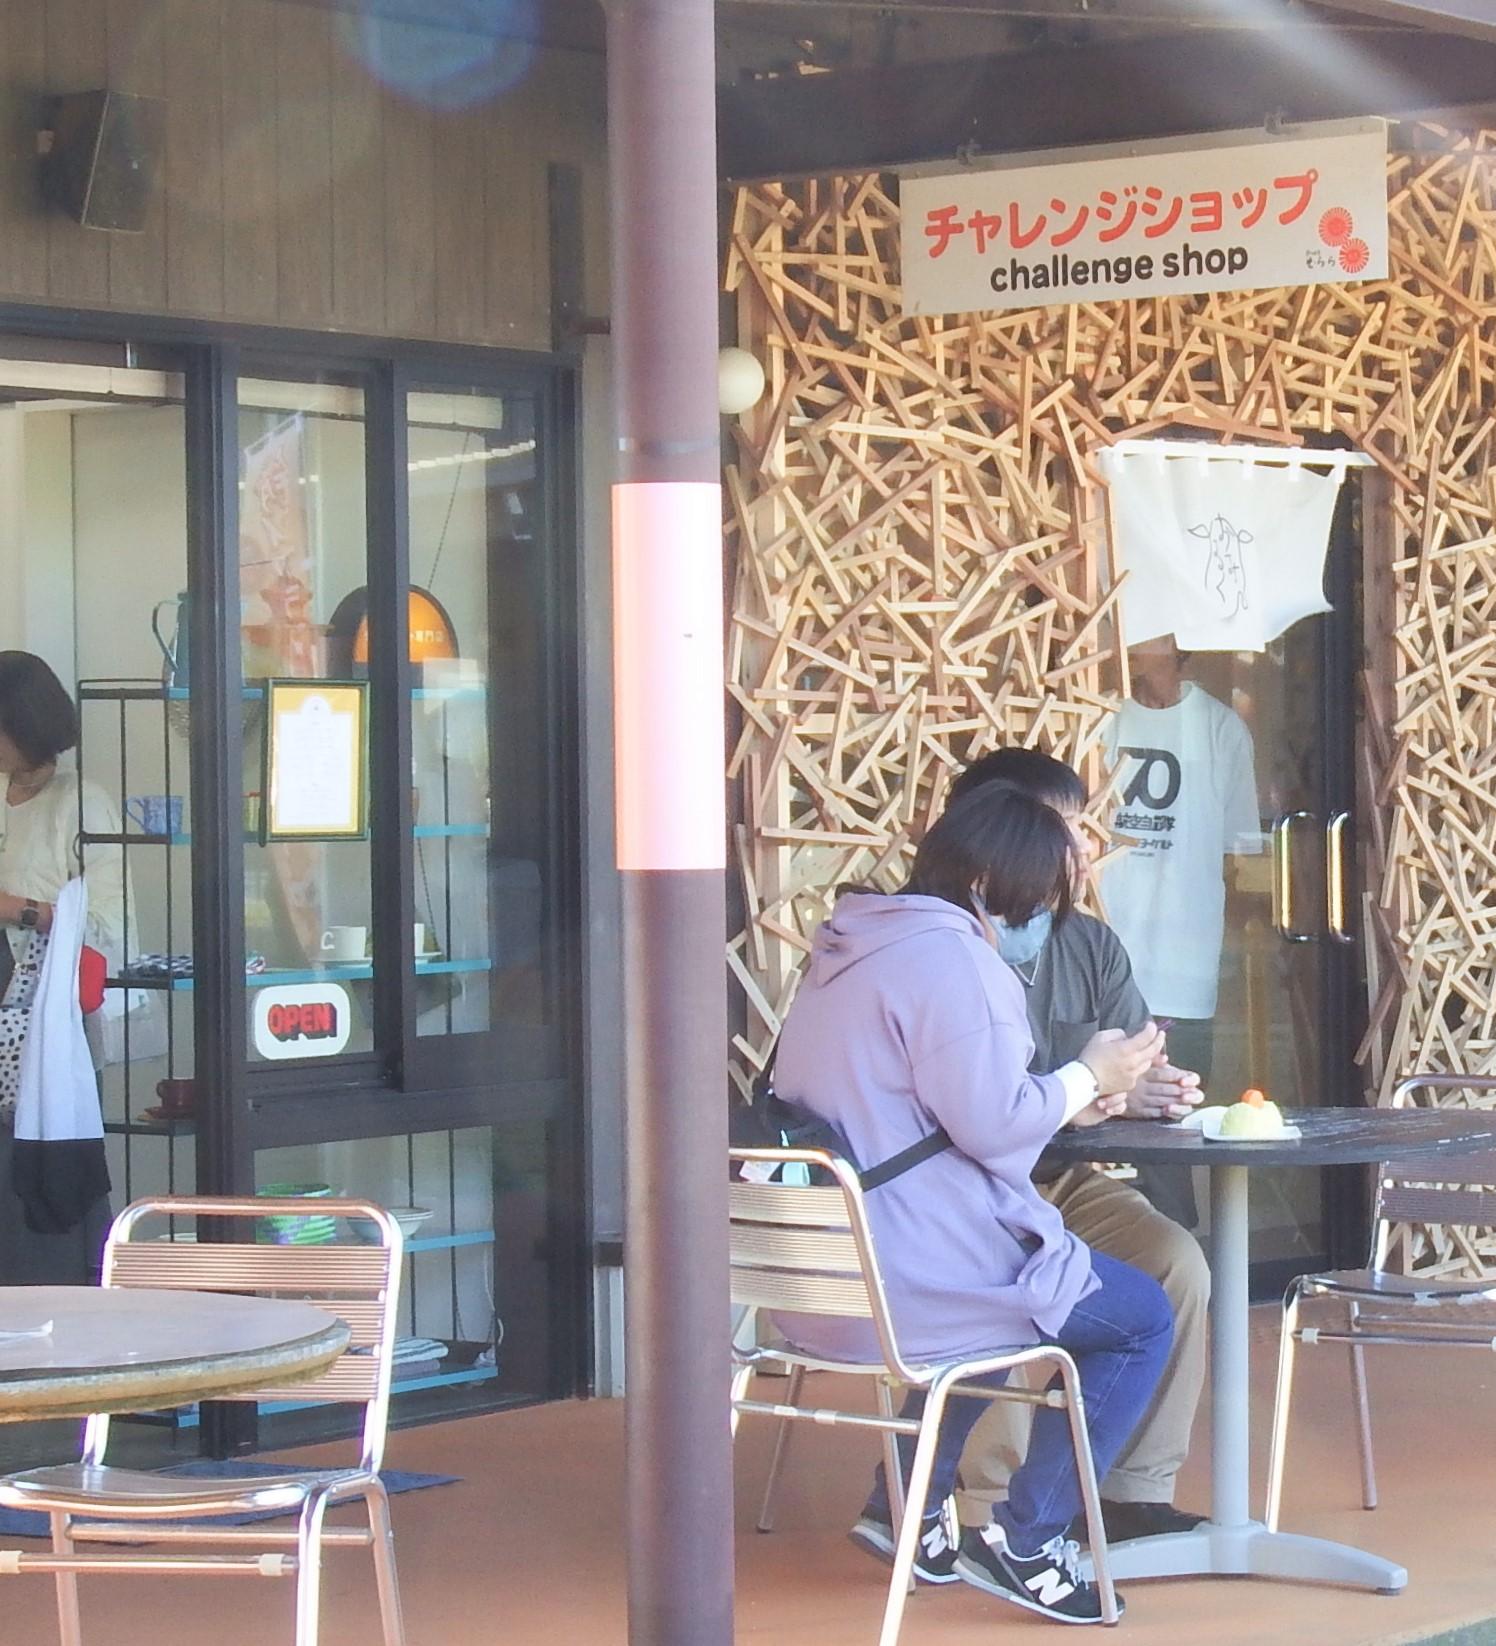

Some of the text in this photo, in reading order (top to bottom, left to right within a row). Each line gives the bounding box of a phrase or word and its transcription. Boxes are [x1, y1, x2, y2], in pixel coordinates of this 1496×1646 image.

[925, 169, 1319, 258] チャレンジショップ
[990, 243, 1249, 292] challenge shop
[1117, 746, 1182, 811] 70
[267, 1002, 337, 1042] OPEN
[1025, 1567, 1076, 1607] N
